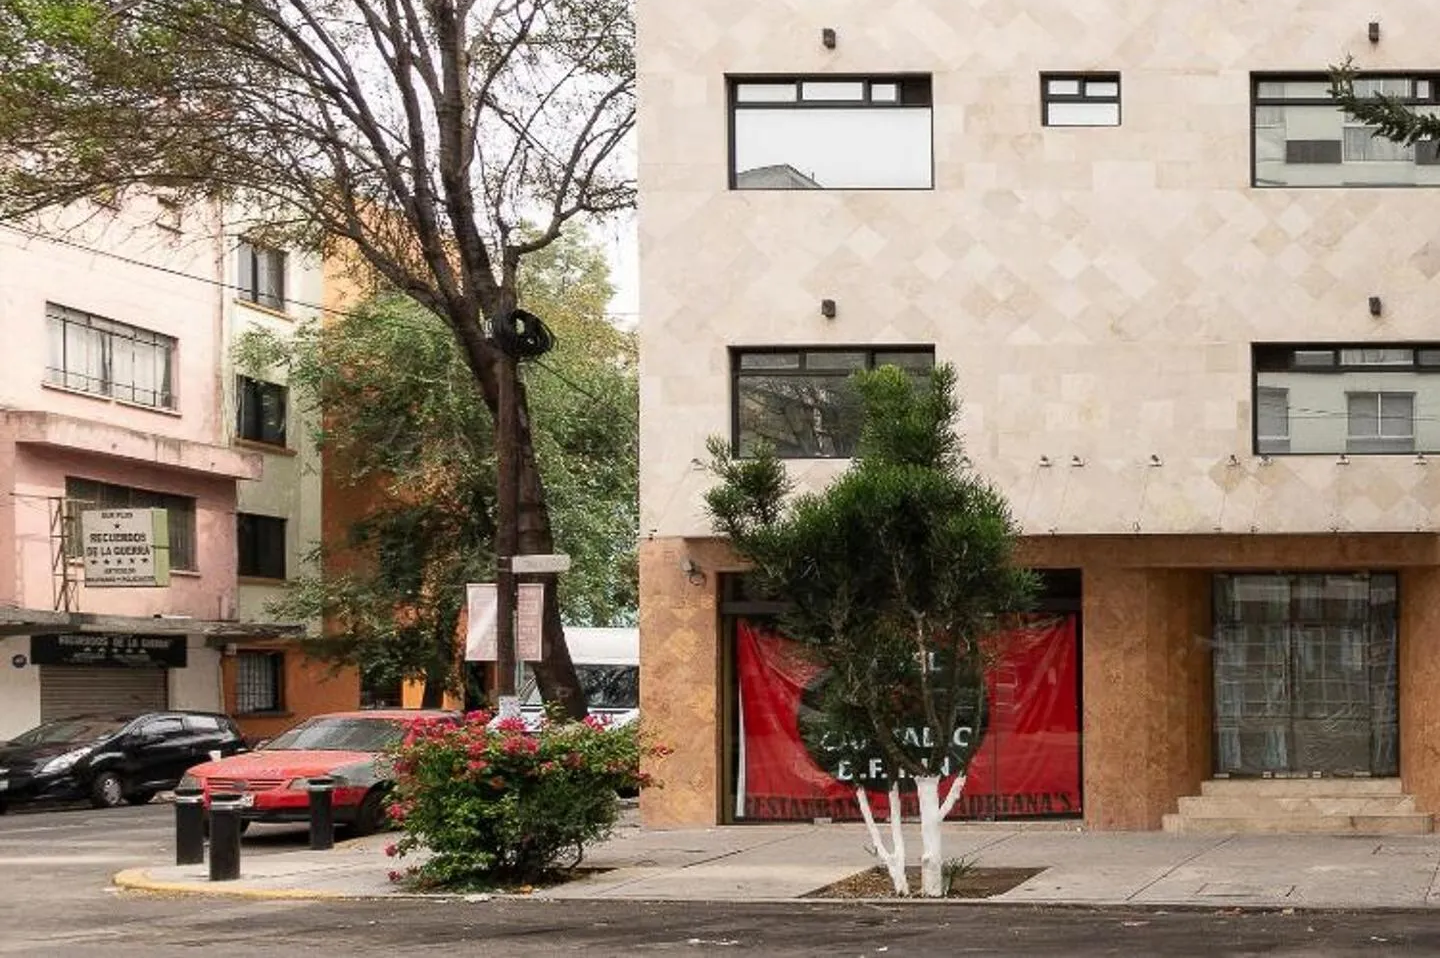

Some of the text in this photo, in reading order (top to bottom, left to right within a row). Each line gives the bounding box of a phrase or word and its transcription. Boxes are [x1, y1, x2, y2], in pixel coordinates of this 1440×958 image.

[89, 532, 147, 543] RECUERDOS
[86, 545, 151, 557] DE LA GUERRA
